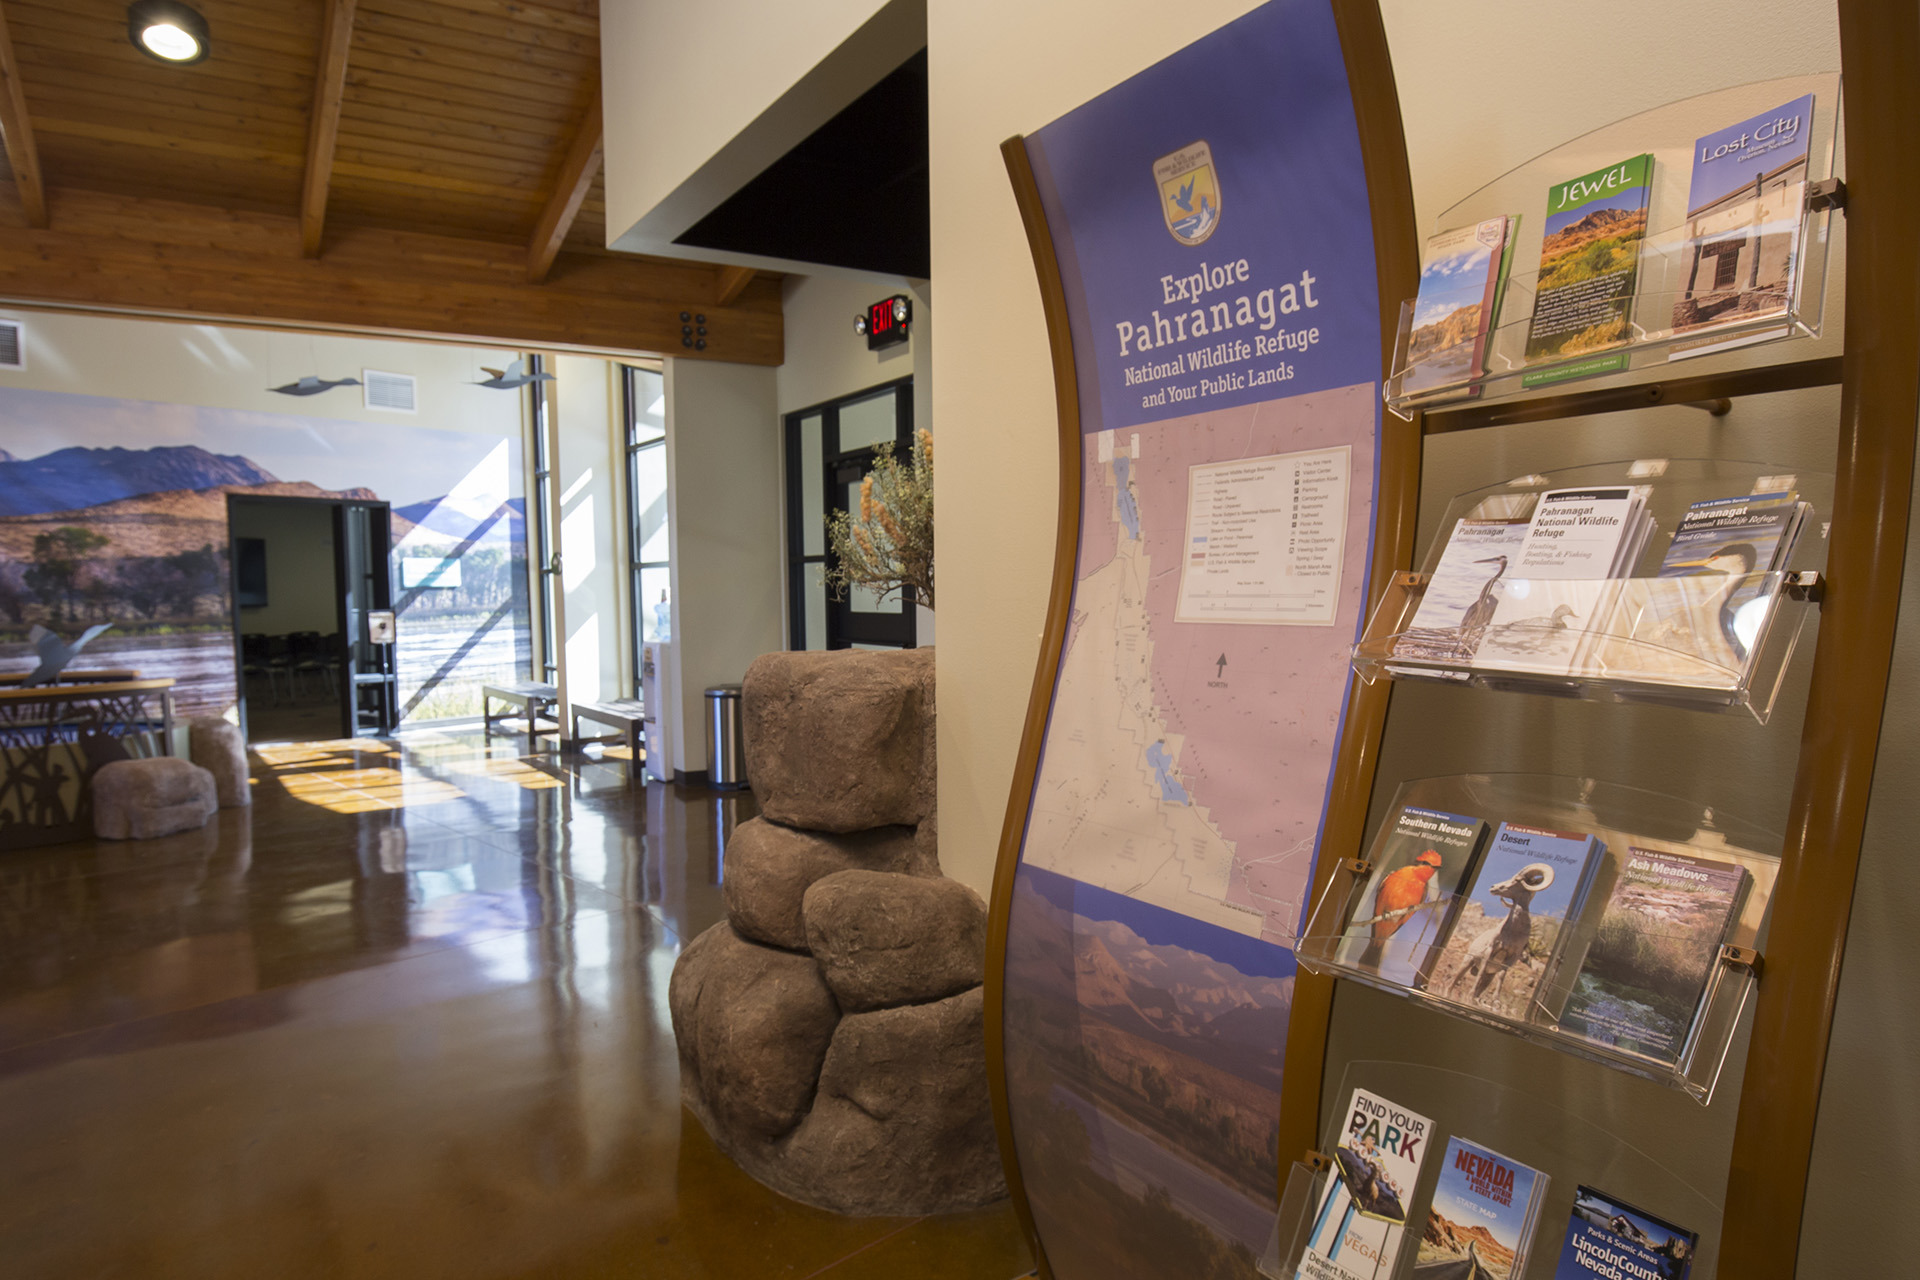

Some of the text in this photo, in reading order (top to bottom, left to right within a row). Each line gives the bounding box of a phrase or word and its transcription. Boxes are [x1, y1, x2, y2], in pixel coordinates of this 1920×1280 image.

[1702, 115, 1800, 163] Lost City
[1557, 165, 1632, 209] JEWEL
[1161, 258, 1250, 304] Explore
[873, 299, 894, 335] EXIT
[1116, 269, 1319, 357] Pahranagat
[1124, 327, 1320, 387] National Wildlife Refuge
[1525, 374, 1543, 382] CLARK
[1544, 369, 1569, 378] COUNTY
[1569, 363, 1601, 373] WETLANDS
[1142, 362, 1295, 409] and Your Public Lands
[1537, 516, 1619, 527] National Wildlife
[1540, 507, 1594, 516] Pahranagat
[1681, 514, 1779, 531] National Wildlife Refuge
[1684, 506, 1748, 522] Pahranagat
[1458, 527, 1505, 536] Pahranagat
[1532, 528, 1565, 539] Refuge
[1676, 532, 1718, 542] Bird Guide
[1563, 551, 1593, 559] Fishing
[1207, 681, 1229, 689] NORTH
[1399, 815, 1473, 837] Southern Nevada
[1500, 833, 1531, 846] Desert
[1628, 858, 1709, 882] Ash Meadows
[1626, 870, 1727, 896] National Wildlife Refuge
[1356, 1096, 1425, 1138] FIND YOUR
[1349, 1110, 1422, 1164] PARK
[1455, 1148, 1515, 1193] NEVADA
[1471, 1176, 1491, 1189] WORLD
[1475, 1186, 1492, 1199] STATE
[1456, 1196, 1497, 1219] STATE MAP
[1349, 1230, 1363, 1241] FROM
[1588, 1226, 1659, 1265] Parks & Scenic Areas
[1344, 1234, 1388, 1267] VEGAS
[1572, 1233, 1667, 1280] LincolnCount
[1308, 1251, 1339, 1275] Desert
[1576, 1250, 1623, 1280] Nevada
